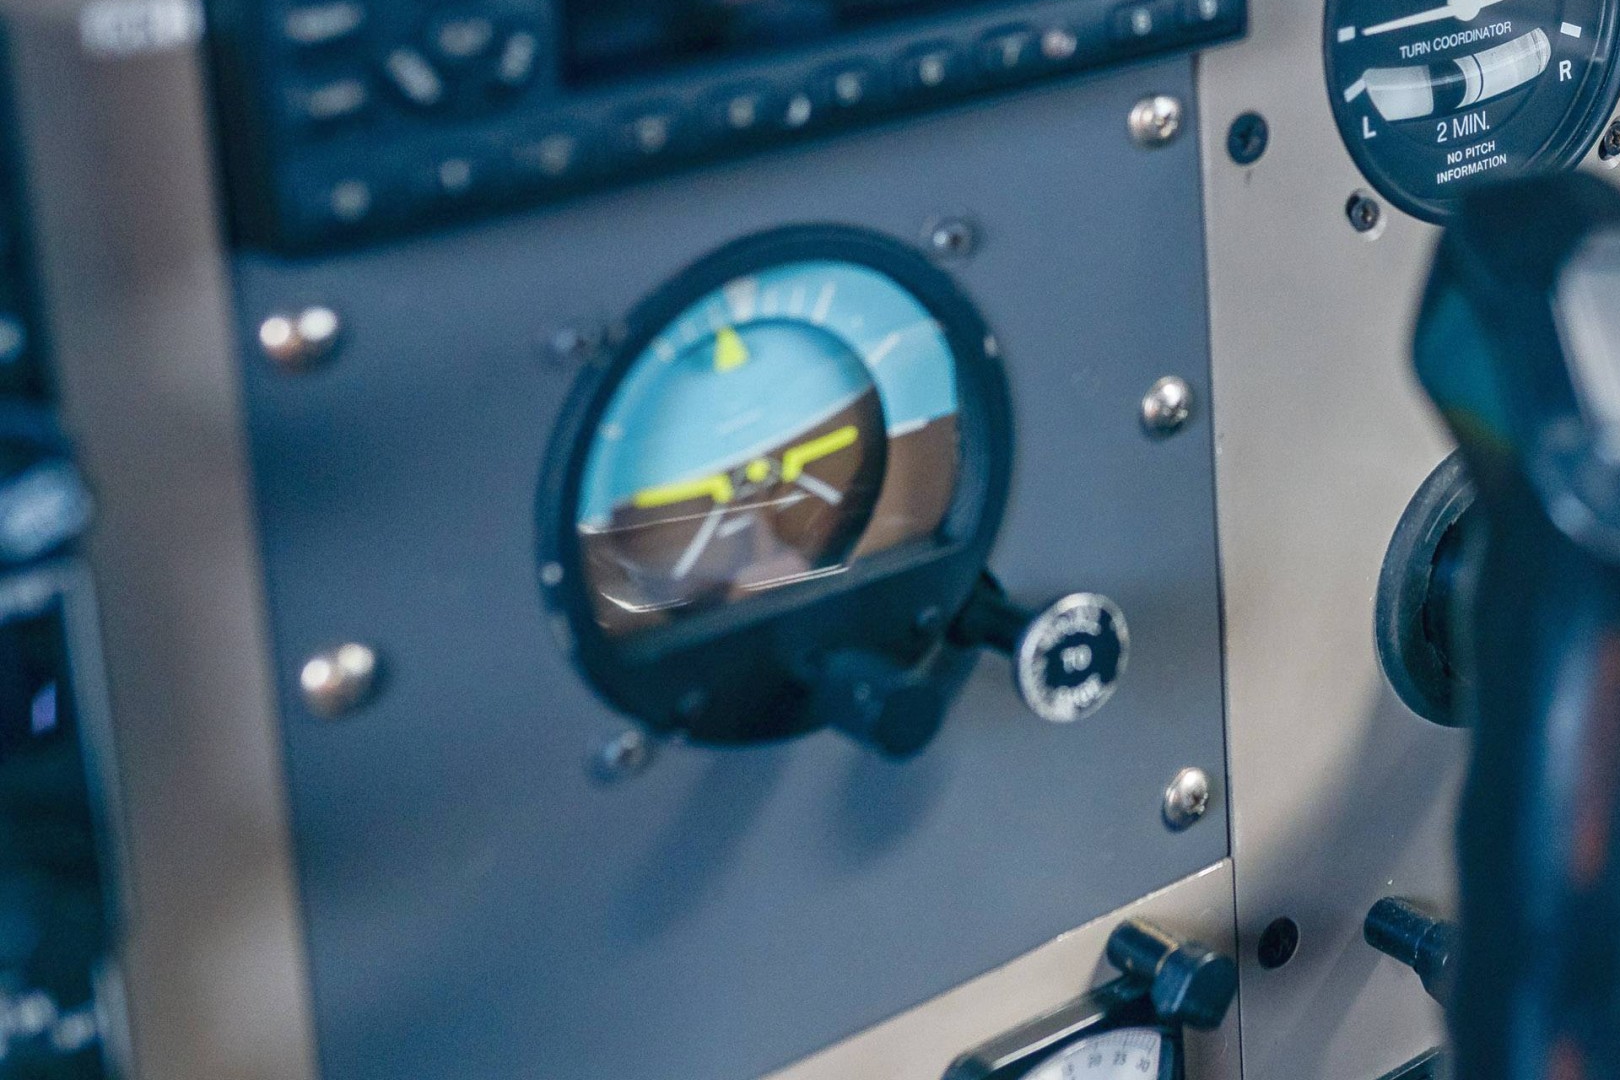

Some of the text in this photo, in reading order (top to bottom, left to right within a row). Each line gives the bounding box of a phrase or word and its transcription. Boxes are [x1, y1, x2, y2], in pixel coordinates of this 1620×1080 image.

[1399, 21, 1512, 60] TURN COORDINATOR
[1559, 60, 1572, 82] R
[1362, 116, 1376, 139] L
[1436, 110, 1490, 143] 2 MIN.
[1447, 140, 1496, 165] NO PITCH
[1436, 153, 1507, 184] INFORMATION
